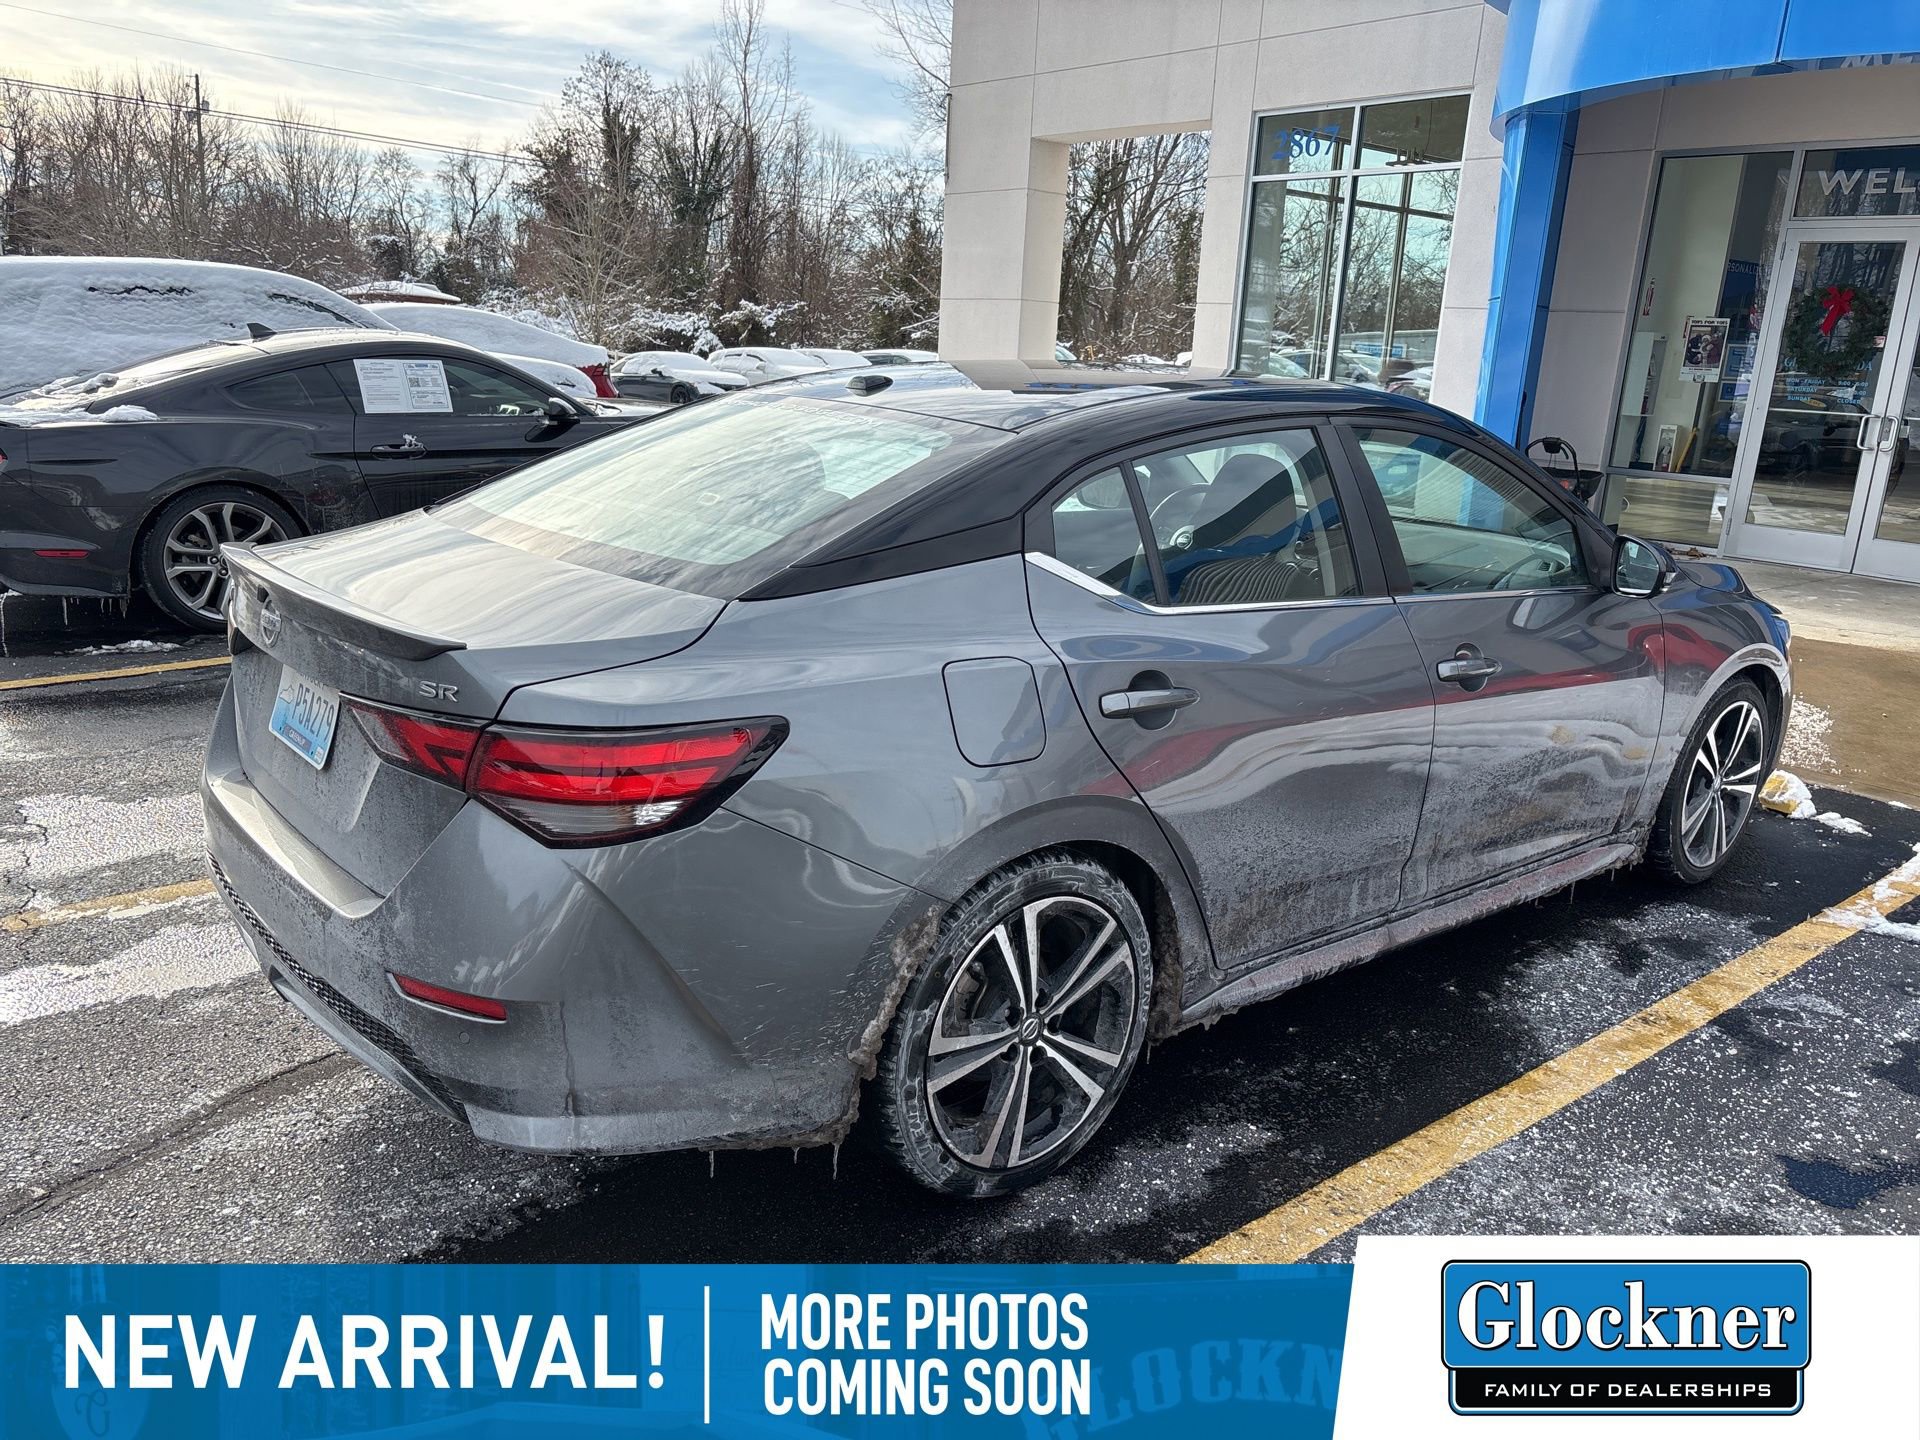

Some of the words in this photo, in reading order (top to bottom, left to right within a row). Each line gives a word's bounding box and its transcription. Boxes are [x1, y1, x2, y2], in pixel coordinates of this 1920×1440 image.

[1271, 122, 1341, 160] 2867
[1818, 167, 1920, 195] WEL
[417, 680, 460, 702] SR
[291, 682, 335, 743] P5A279
